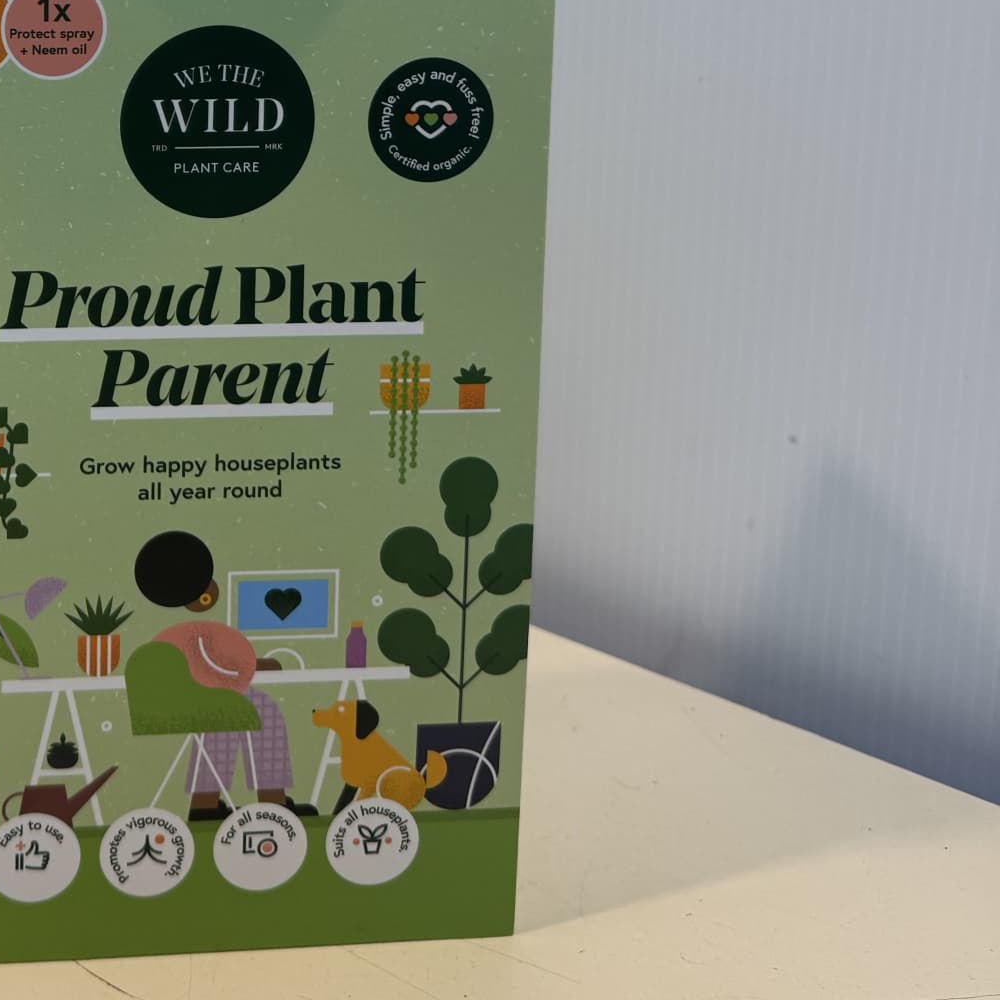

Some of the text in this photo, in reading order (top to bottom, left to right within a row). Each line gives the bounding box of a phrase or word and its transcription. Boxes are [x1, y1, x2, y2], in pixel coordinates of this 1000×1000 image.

[9, 28, 95, 42] Protect spray
[32, 44, 68, 55] Neem
[71, 44, 87, 55] oil
[173, 64, 265, 88] WE THE
[152, 97, 285, 133] WILD
[379, 71, 484, 140] Simple, easy and fuss free!
[151, 144, 168, 152] TRD
[388, 144, 473, 171] Certified organic.
[174, 162, 259, 173] PLANT CARE
[0, 264, 426, 329] Proud Plant
[91, 347, 335, 407] Parent
[79, 452, 342, 477] Grow happy houseplants
[138, 479, 282, 505] all year round
[28, 820, 42, 831] to
[44, 825, 65, 844] use.
[221, 810, 297, 846] For all seasons.
[333, 805, 411, 859] Suits all houseplants.
[125, 816, 178, 836] vigorous
[164, 834, 185, 877] growth.
